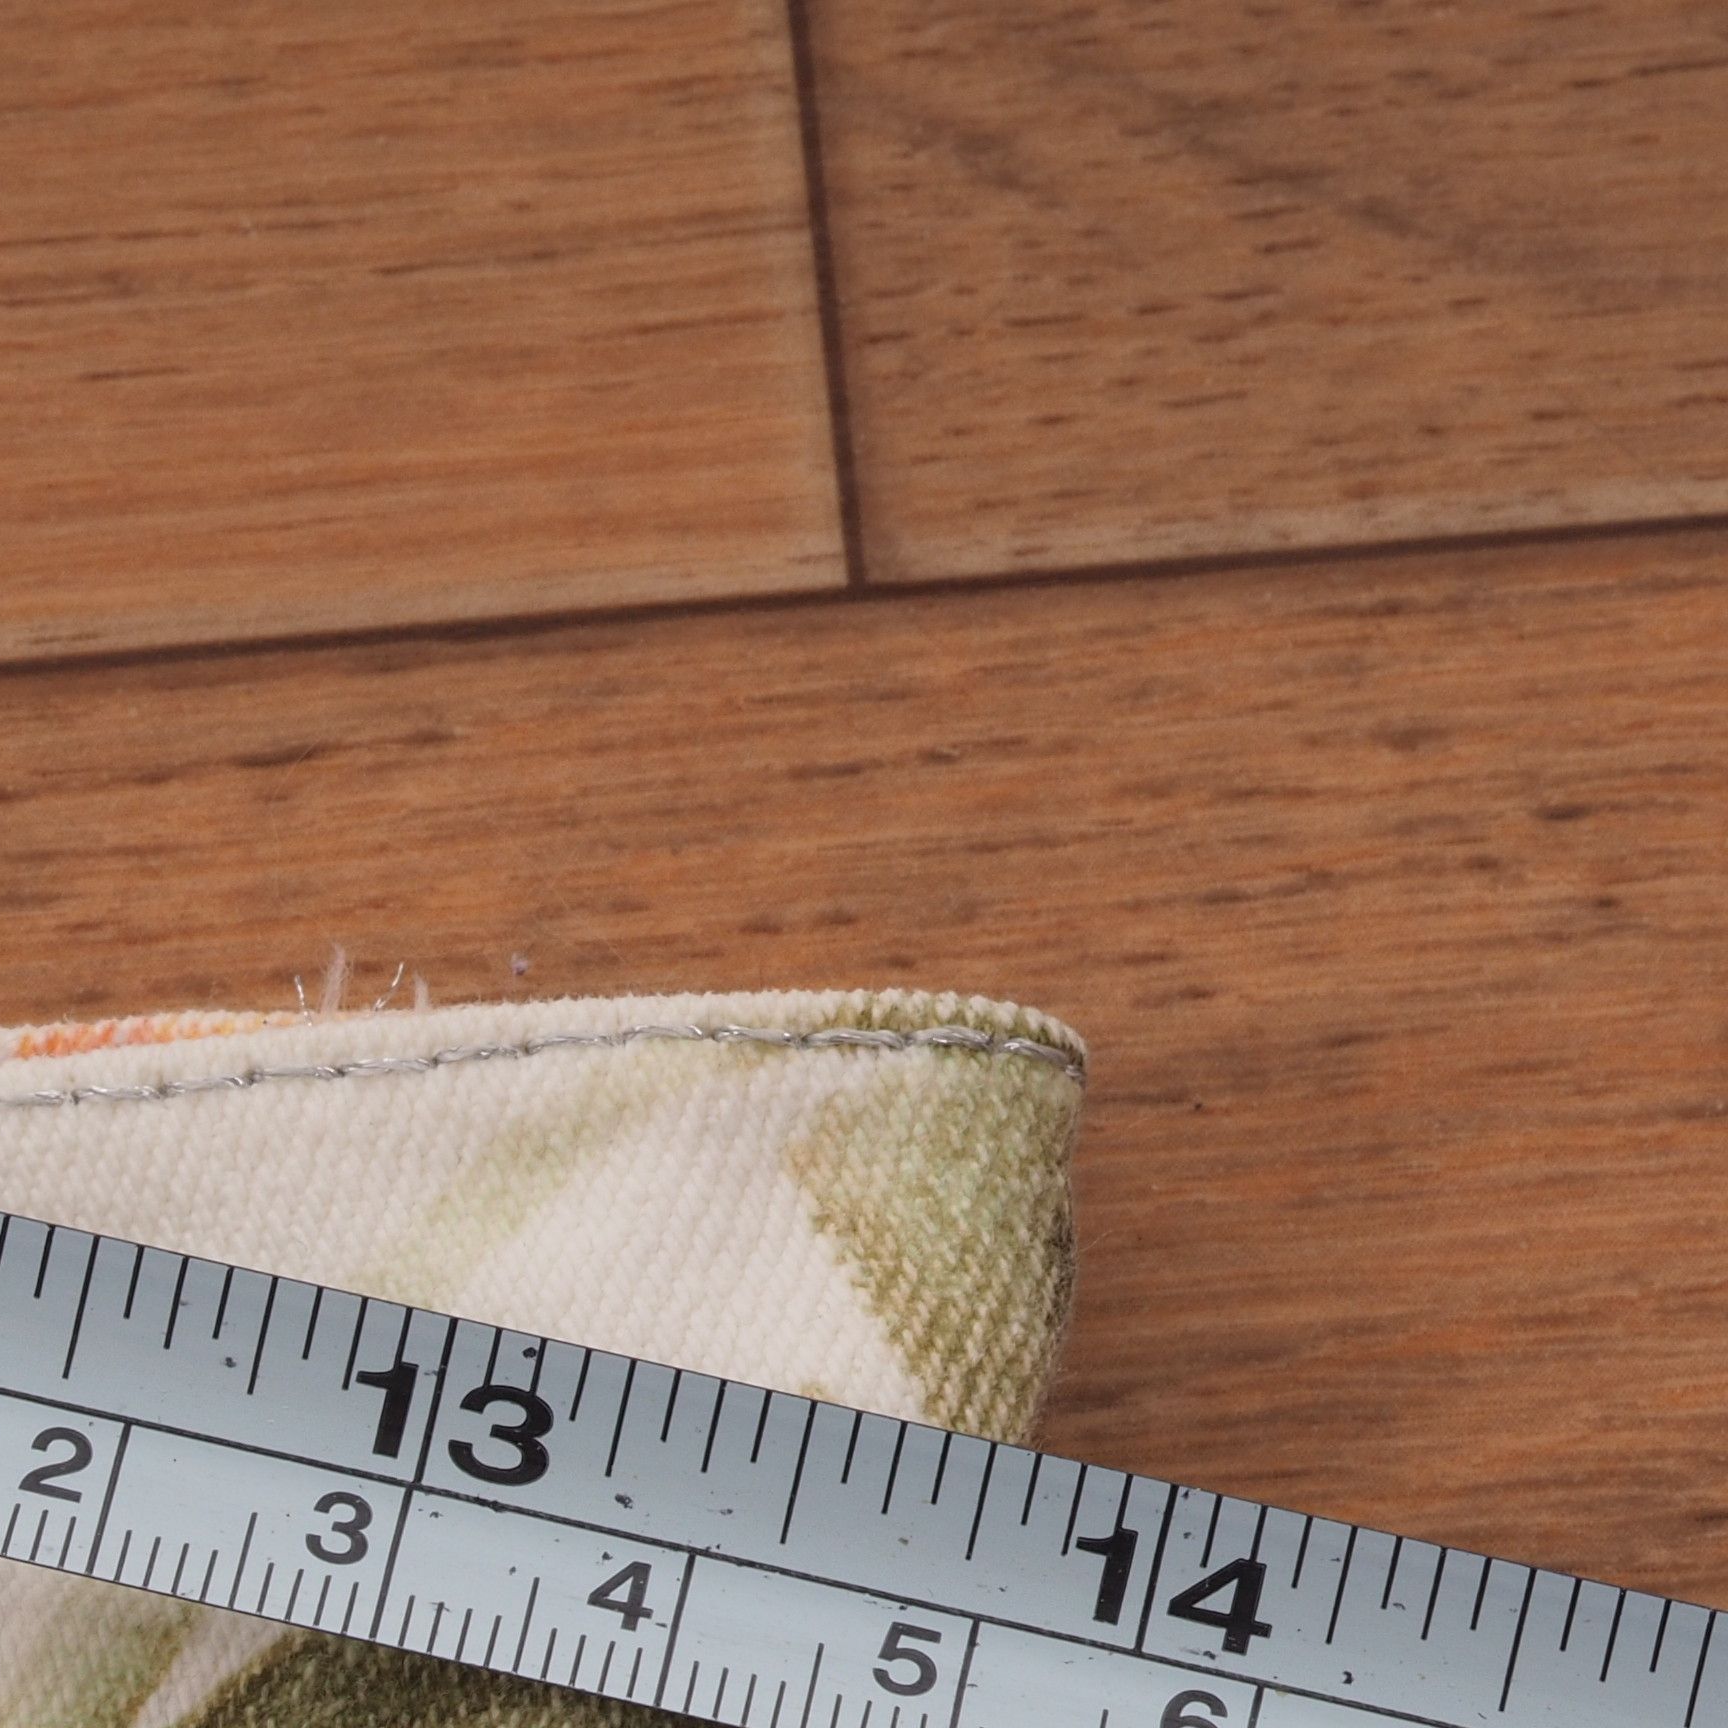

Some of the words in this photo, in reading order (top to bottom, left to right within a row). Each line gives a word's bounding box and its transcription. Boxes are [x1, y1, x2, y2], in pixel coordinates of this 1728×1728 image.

[18, 1426, 94, 1503] 2
[305, 1491, 373, 1565] 3
[586, 1561, 653, 1631] 4
[872, 1622, 942, 1696] 5
[356, 1362, 554, 1486] 13
[1076, 1528, 1271, 1655] 14
